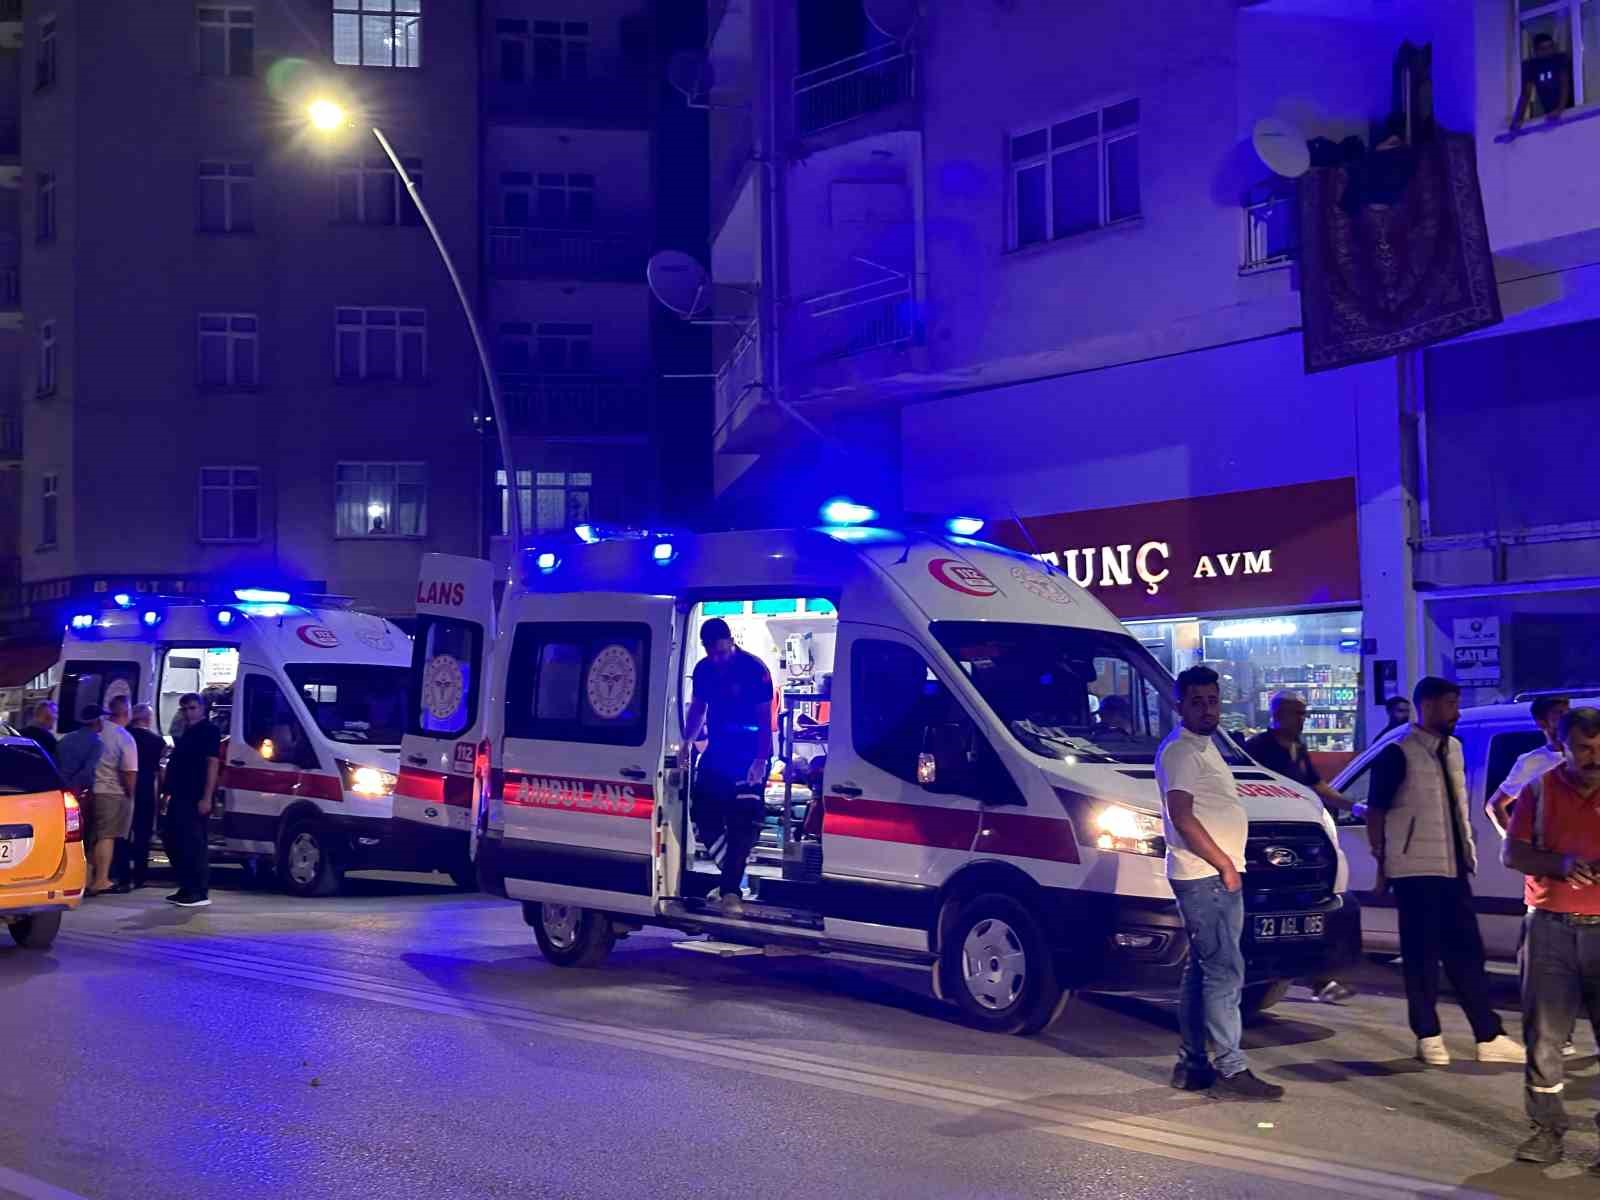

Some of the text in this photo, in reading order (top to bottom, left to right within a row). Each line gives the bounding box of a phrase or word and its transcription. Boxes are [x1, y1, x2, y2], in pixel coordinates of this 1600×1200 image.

[1194, 550, 1273, 578] AVM
[416, 580, 465, 606] LANS
[516, 777, 636, 813] AMBULANS
[1261, 918, 1275, 936] 23
